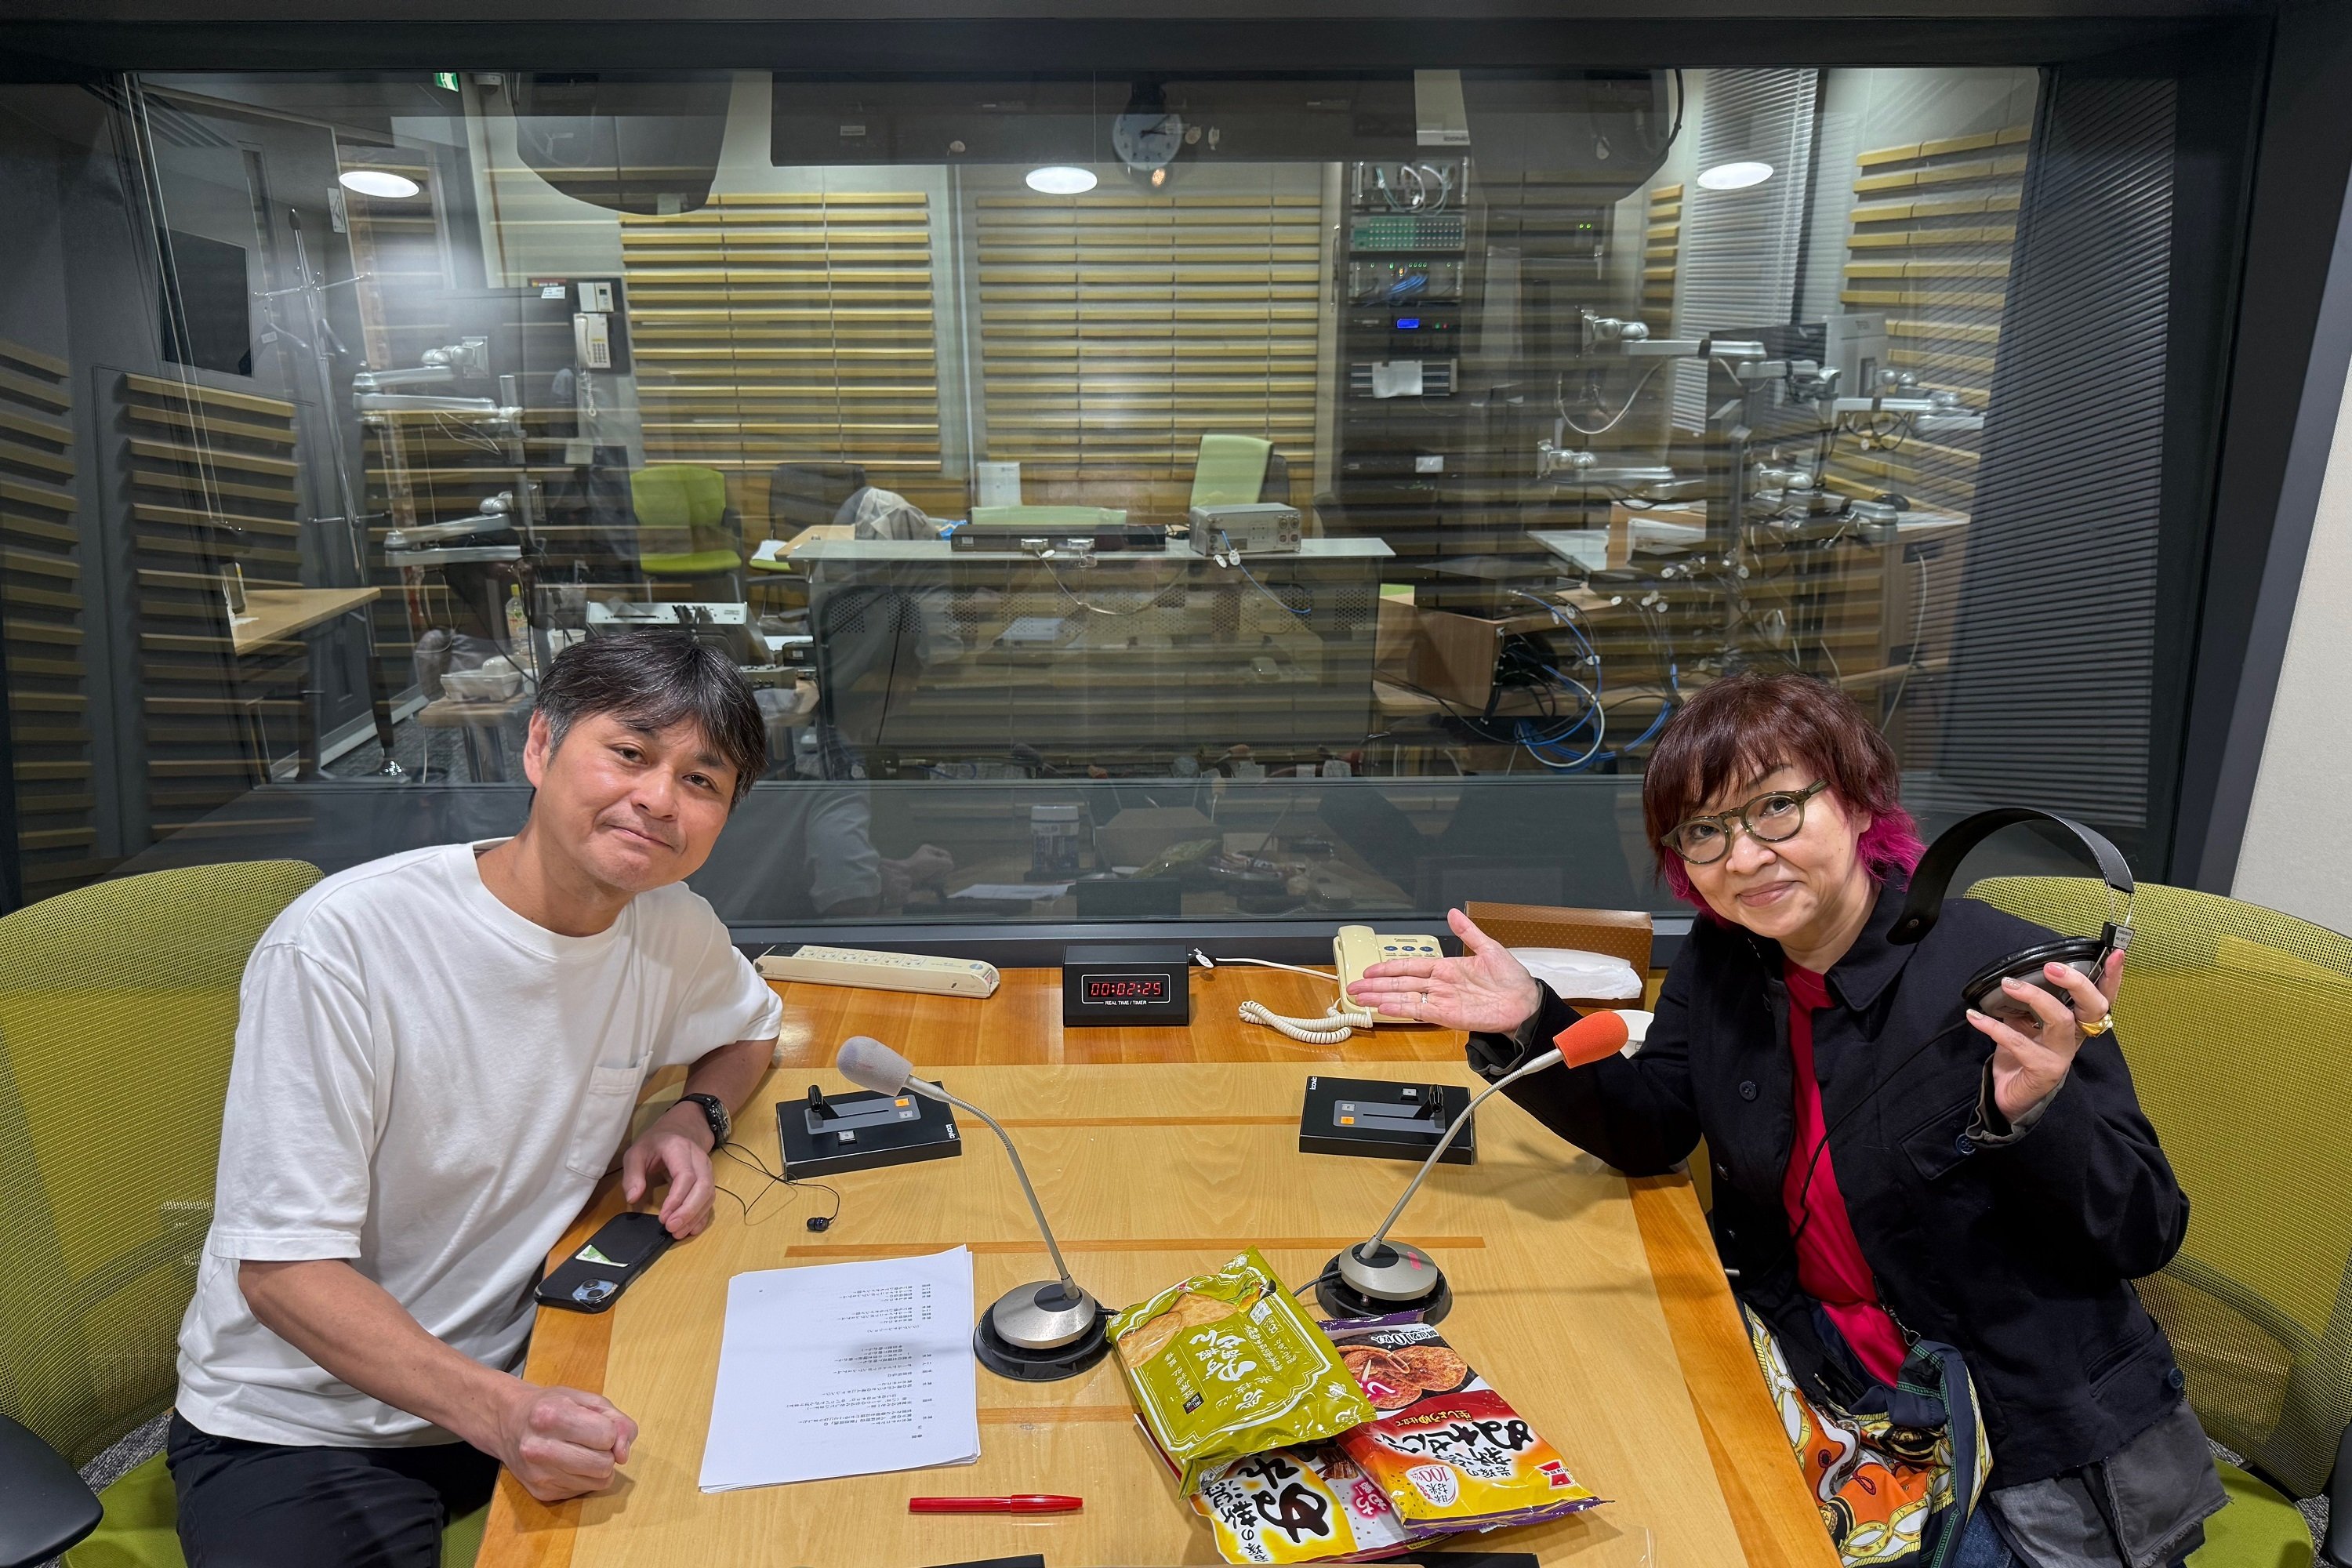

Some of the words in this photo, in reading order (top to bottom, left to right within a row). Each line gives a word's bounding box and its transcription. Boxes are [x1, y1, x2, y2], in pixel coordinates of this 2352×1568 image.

[1091, 982, 1162, 996] 00:02:25
[1375, 1420, 1534, 1454] ぬれせんべい
[1410, 1467, 1450, 1482] 100%
